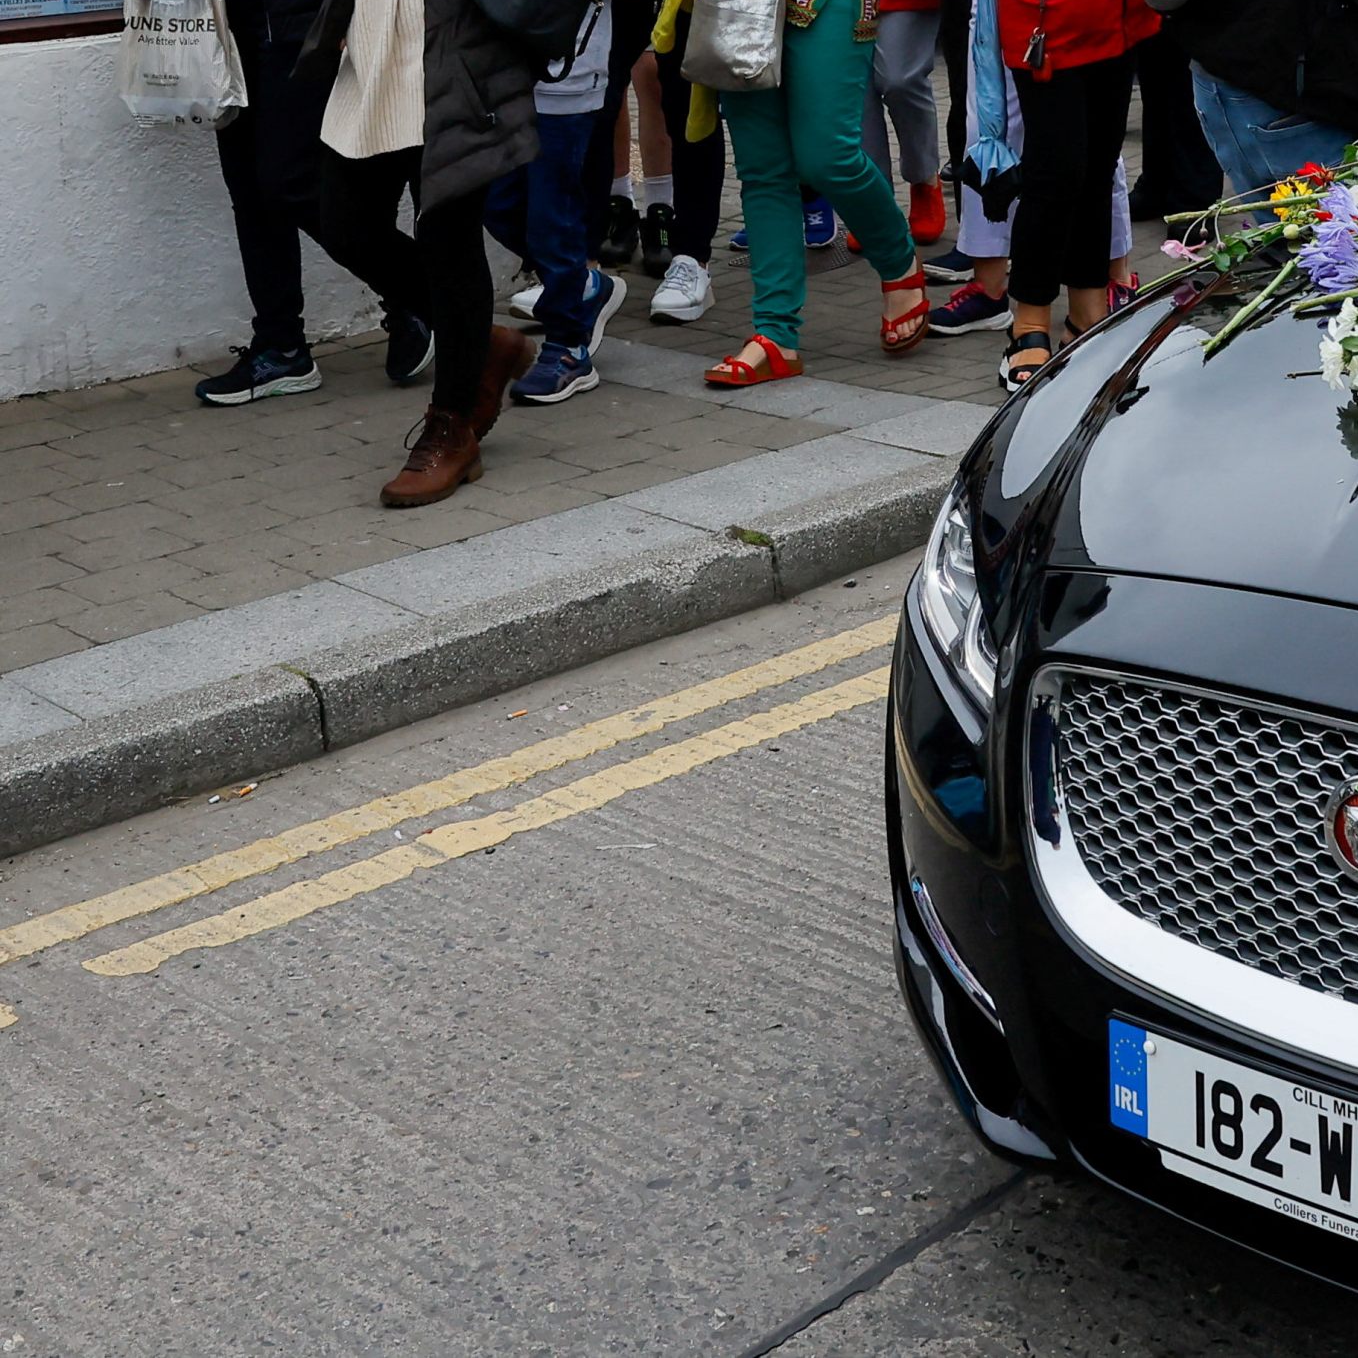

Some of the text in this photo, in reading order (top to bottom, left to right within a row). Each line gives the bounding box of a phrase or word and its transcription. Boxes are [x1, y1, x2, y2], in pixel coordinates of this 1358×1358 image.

[1115, 1084, 1143, 1117] IRL
[1293, 1087, 1328, 1111] CILL
[1274, 1198, 1317, 1223] Colliers
